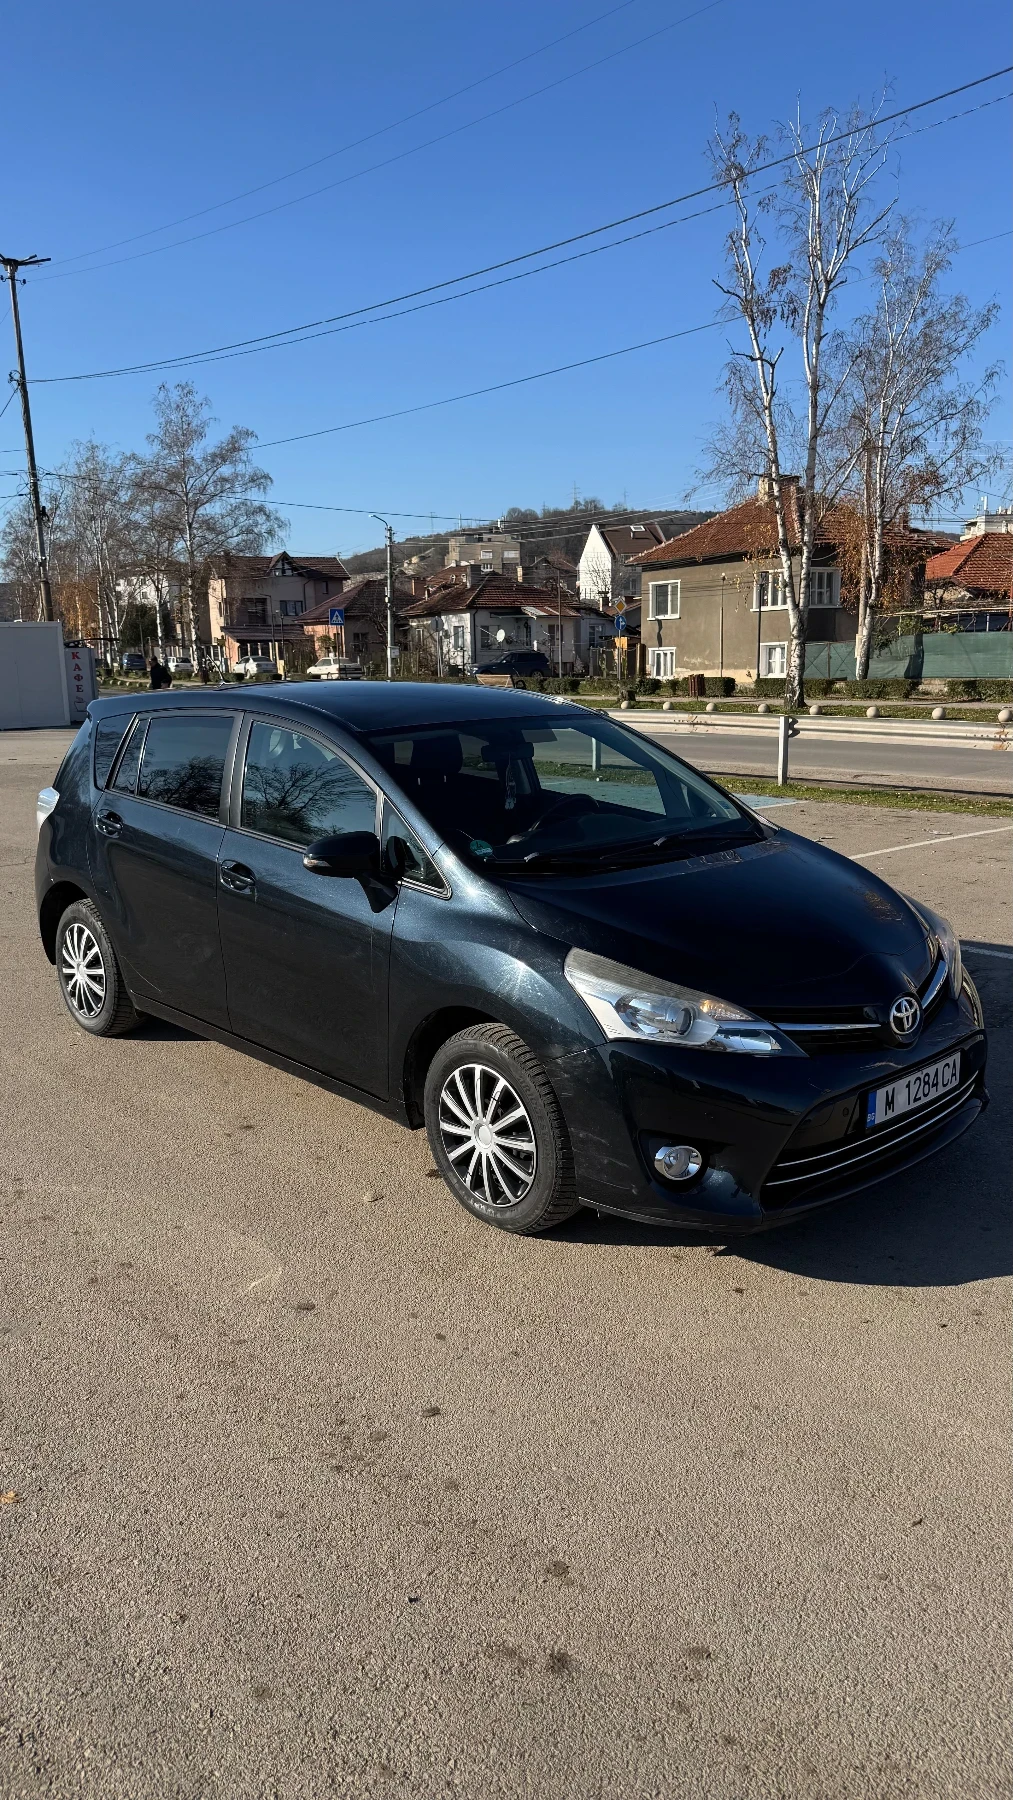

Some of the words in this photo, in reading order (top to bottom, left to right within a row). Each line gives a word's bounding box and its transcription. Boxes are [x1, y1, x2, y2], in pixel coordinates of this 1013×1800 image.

[71, 651, 84, 693] КАФЕ
[866, 1112, 876, 1122] BG
[884, 1086, 896, 1117] M
